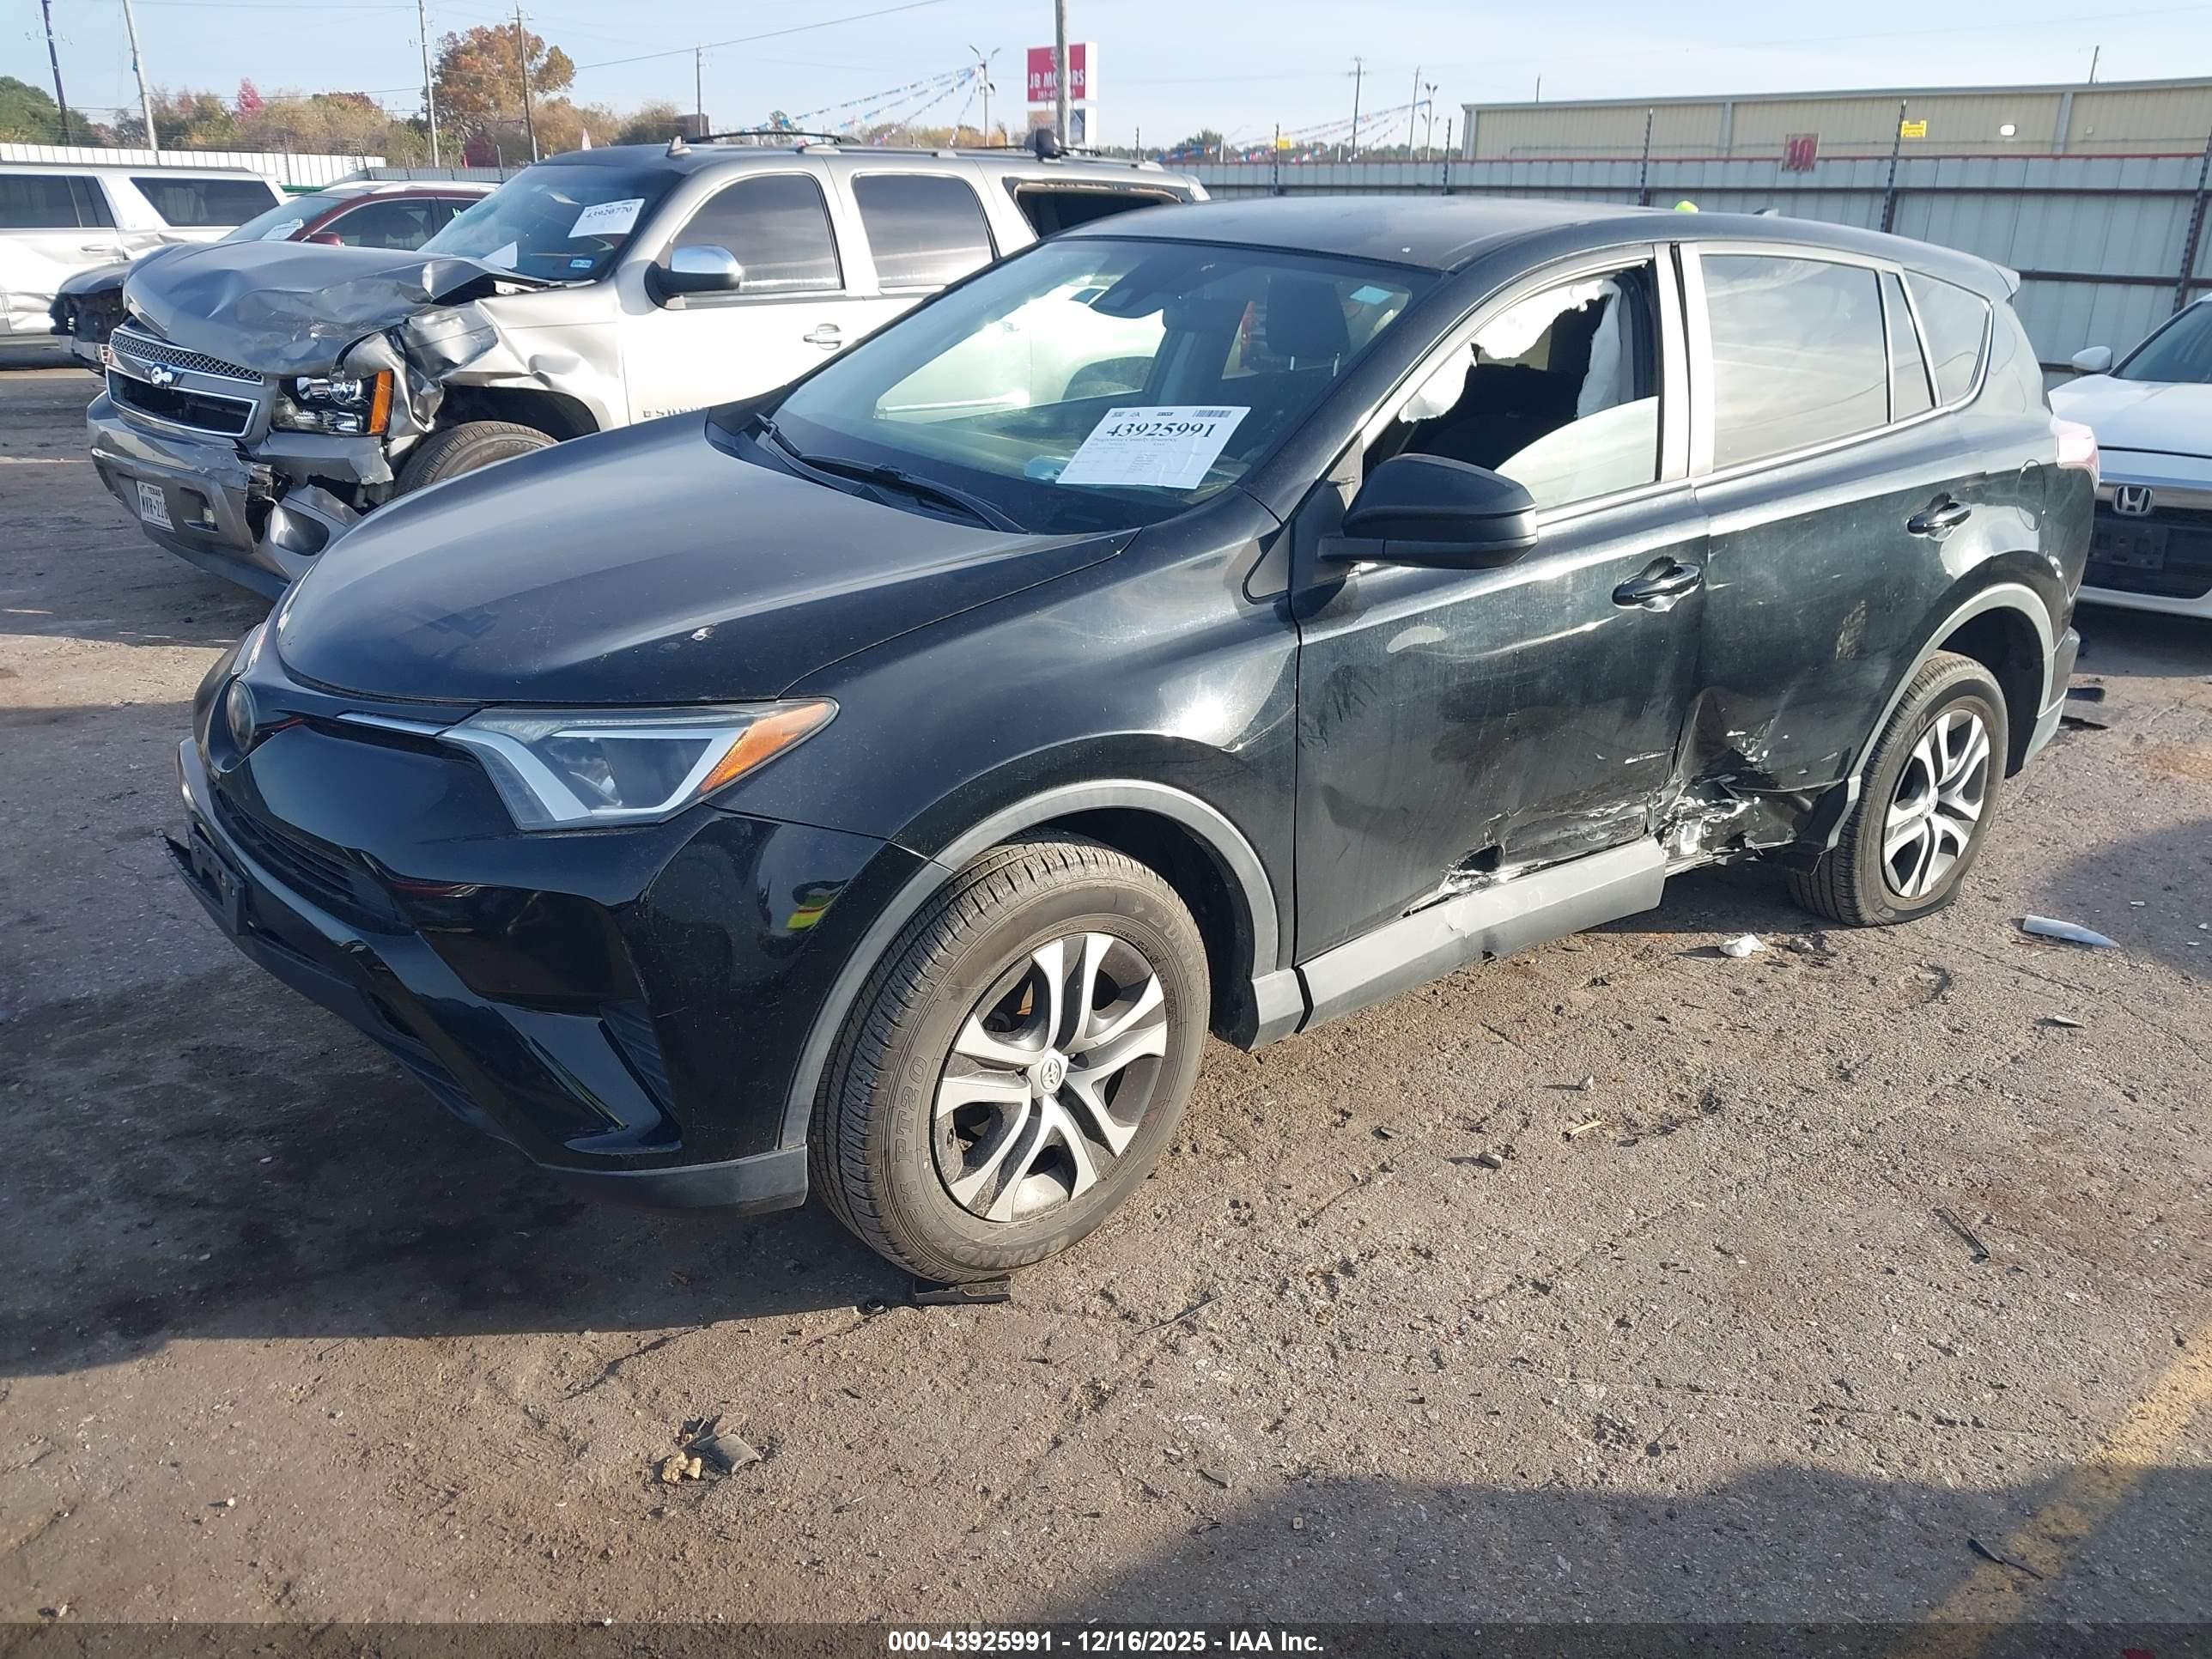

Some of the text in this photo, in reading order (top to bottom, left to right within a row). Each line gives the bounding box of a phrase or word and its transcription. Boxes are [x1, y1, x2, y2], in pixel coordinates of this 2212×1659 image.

[1029, 71, 1041, 89] JB
[1106, 422, 1217, 438] 43925991
[895, 1055, 928, 1164] PT20
